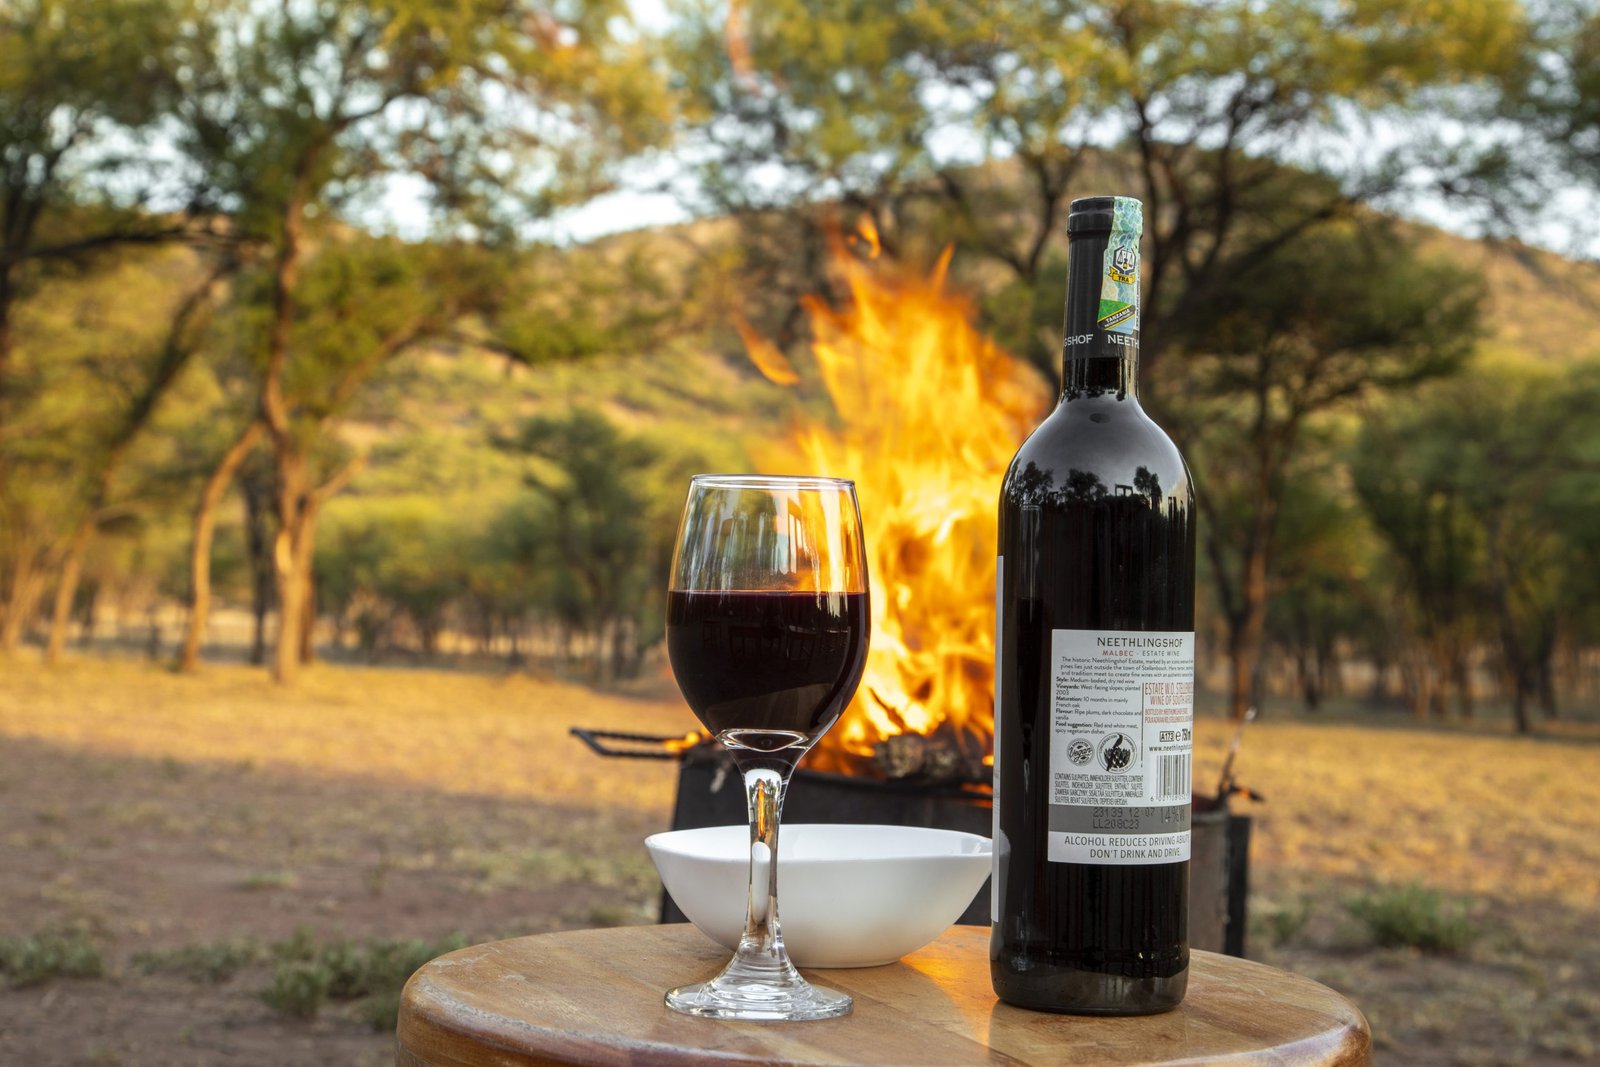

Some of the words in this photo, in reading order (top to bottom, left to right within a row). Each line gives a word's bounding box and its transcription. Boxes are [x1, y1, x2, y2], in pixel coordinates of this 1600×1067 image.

[1106, 308, 1130, 322] TANZANIA
[1097, 637, 1183, 648] NEETHLINGSHOF
[1145, 682, 1164, 695] ESTATE
[1150, 696, 1164, 705] WINE
[1166, 696, 1172, 705] OF
[1161, 732, 1174, 740] A173
[1064, 836, 1106, 846] ALCOHOL
[1109, 837, 1147, 847] REDUCES
[1149, 836, 1176, 846] DRIVING
[1090, 849, 1117, 859] DON'T
[1120, 849, 1145, 859] DRINK
[1148, 848, 1162, 858] AND
